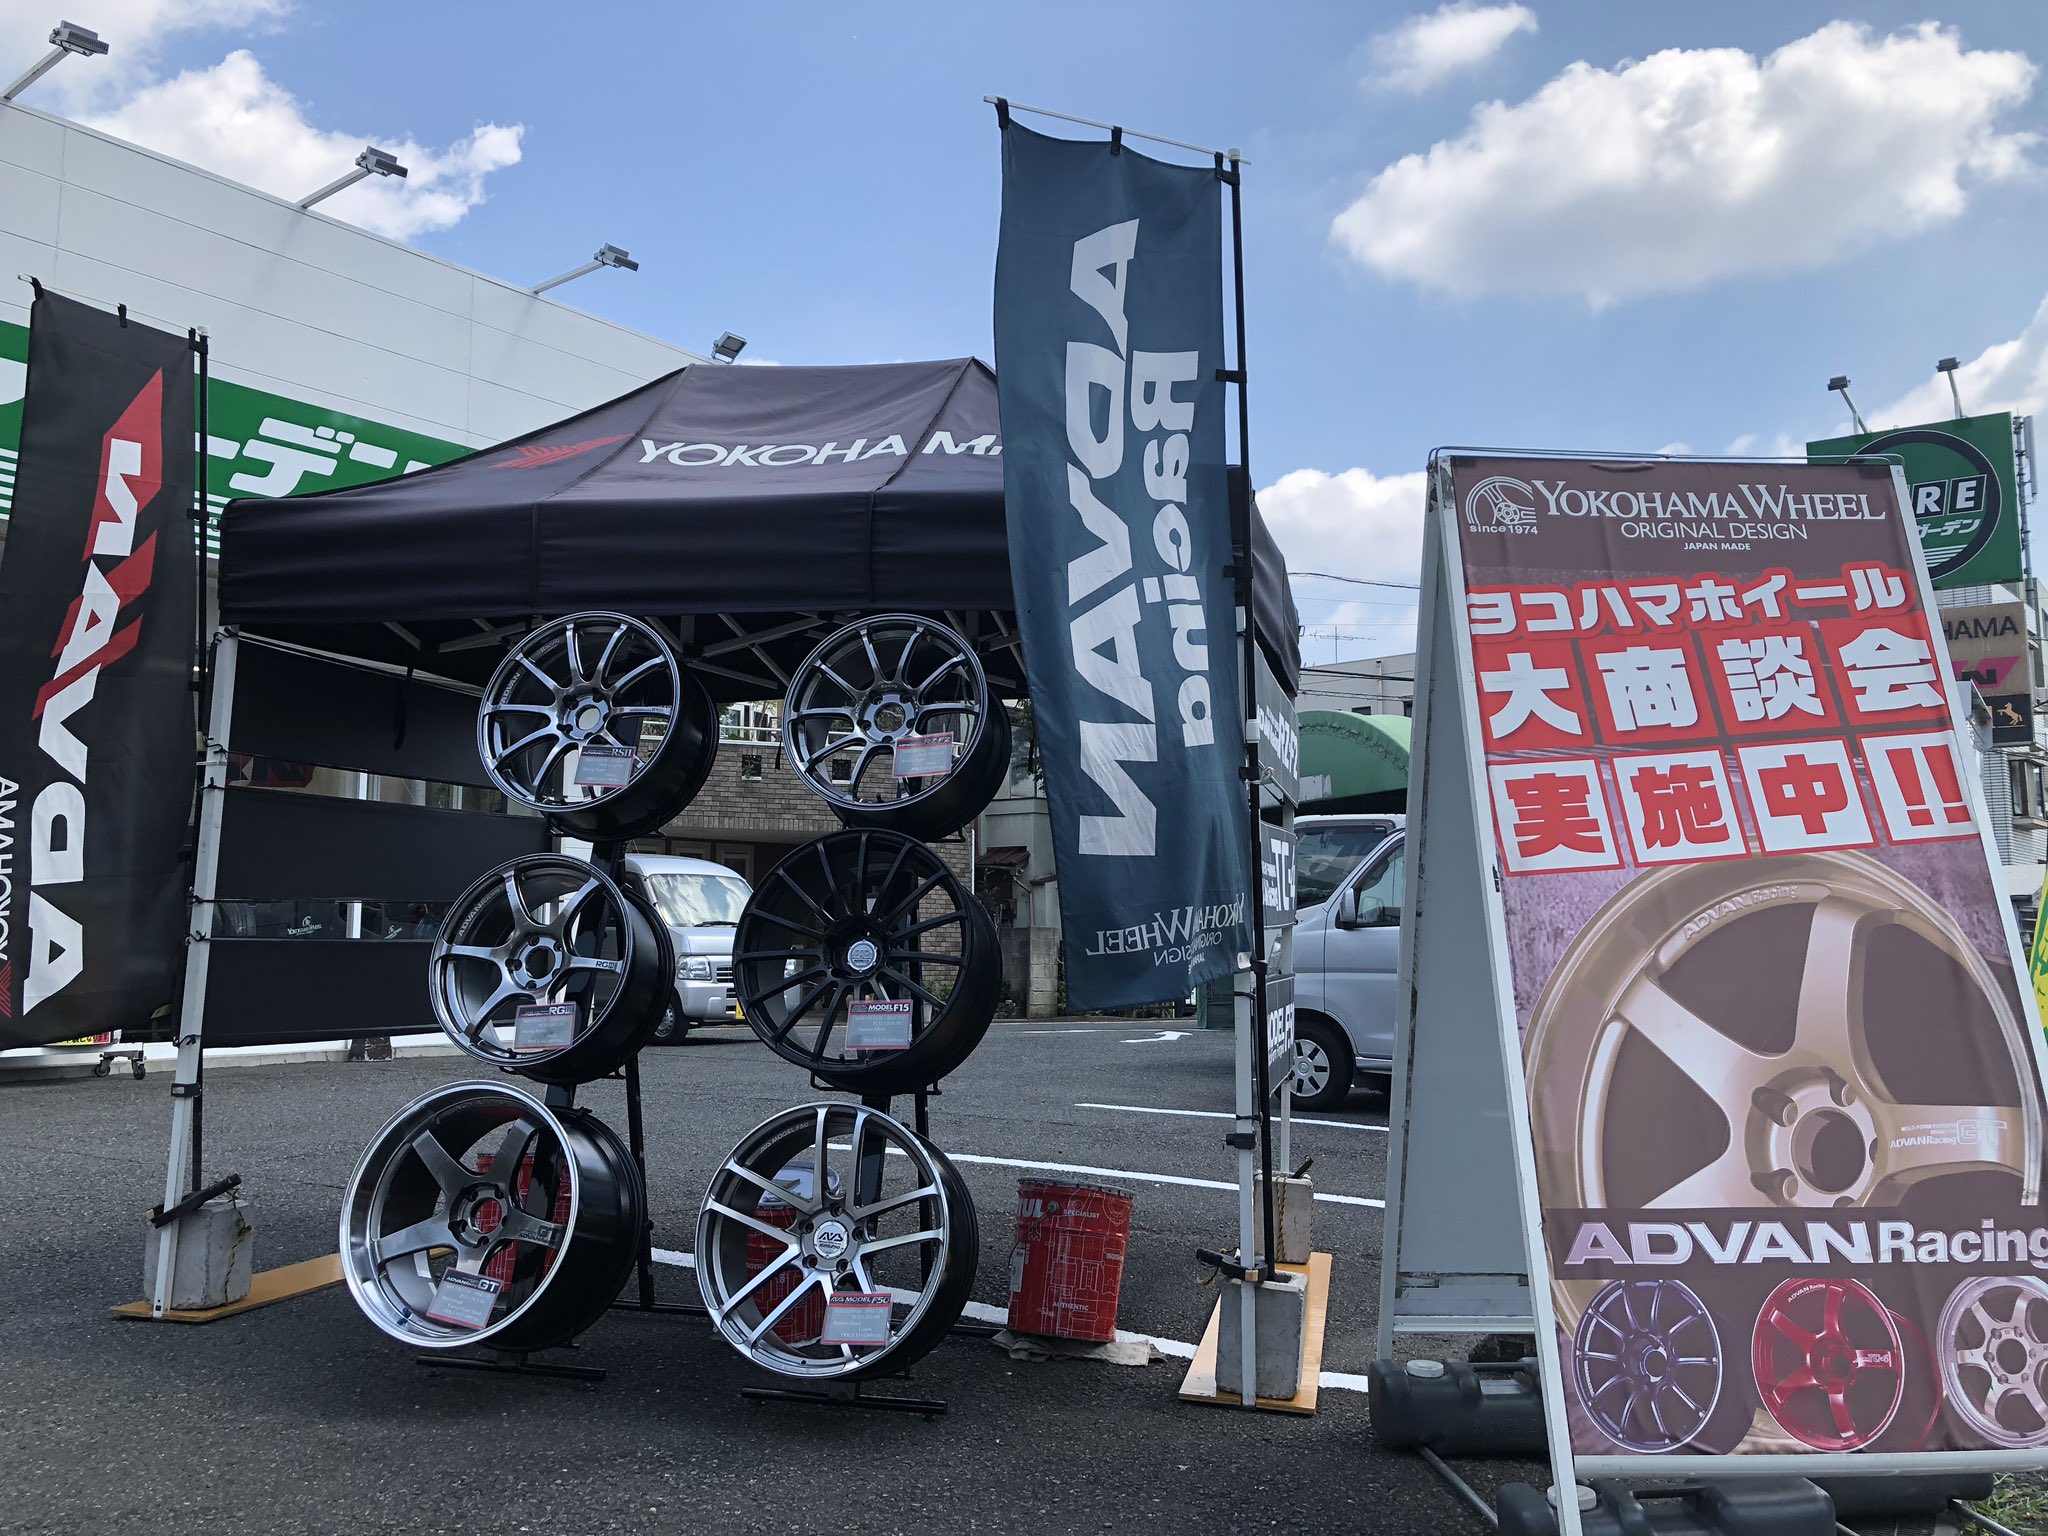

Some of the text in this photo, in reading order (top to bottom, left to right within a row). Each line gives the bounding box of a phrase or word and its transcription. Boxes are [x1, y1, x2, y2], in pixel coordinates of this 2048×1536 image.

[1531, 479, 1886, 520] YOKOHAMA WHEEL
[1469, 524, 1539, 534] since 1974
[1620, 521, 1808, 540] ORIGINAL DESIGN
[1683, 541, 1751, 551] JAPAN MADE
[1469, 567, 1907, 635] ヨコハマホイール
[1480, 627, 1946, 739] 大商談会
[1683, 885, 1798, 940] ADVAN Racing
[893, 1003, 909, 1012] F15
[1889, 1136, 1926, 1149] ADVAN
[1926, 1135, 1957, 1146] Racing
[1063, 1208, 1100, 1219] SPECIALIST
[1564, 1218, 2048, 1269] ADVAN Racing
[1052, 1301, 1089, 1311] AUTHENTIC
